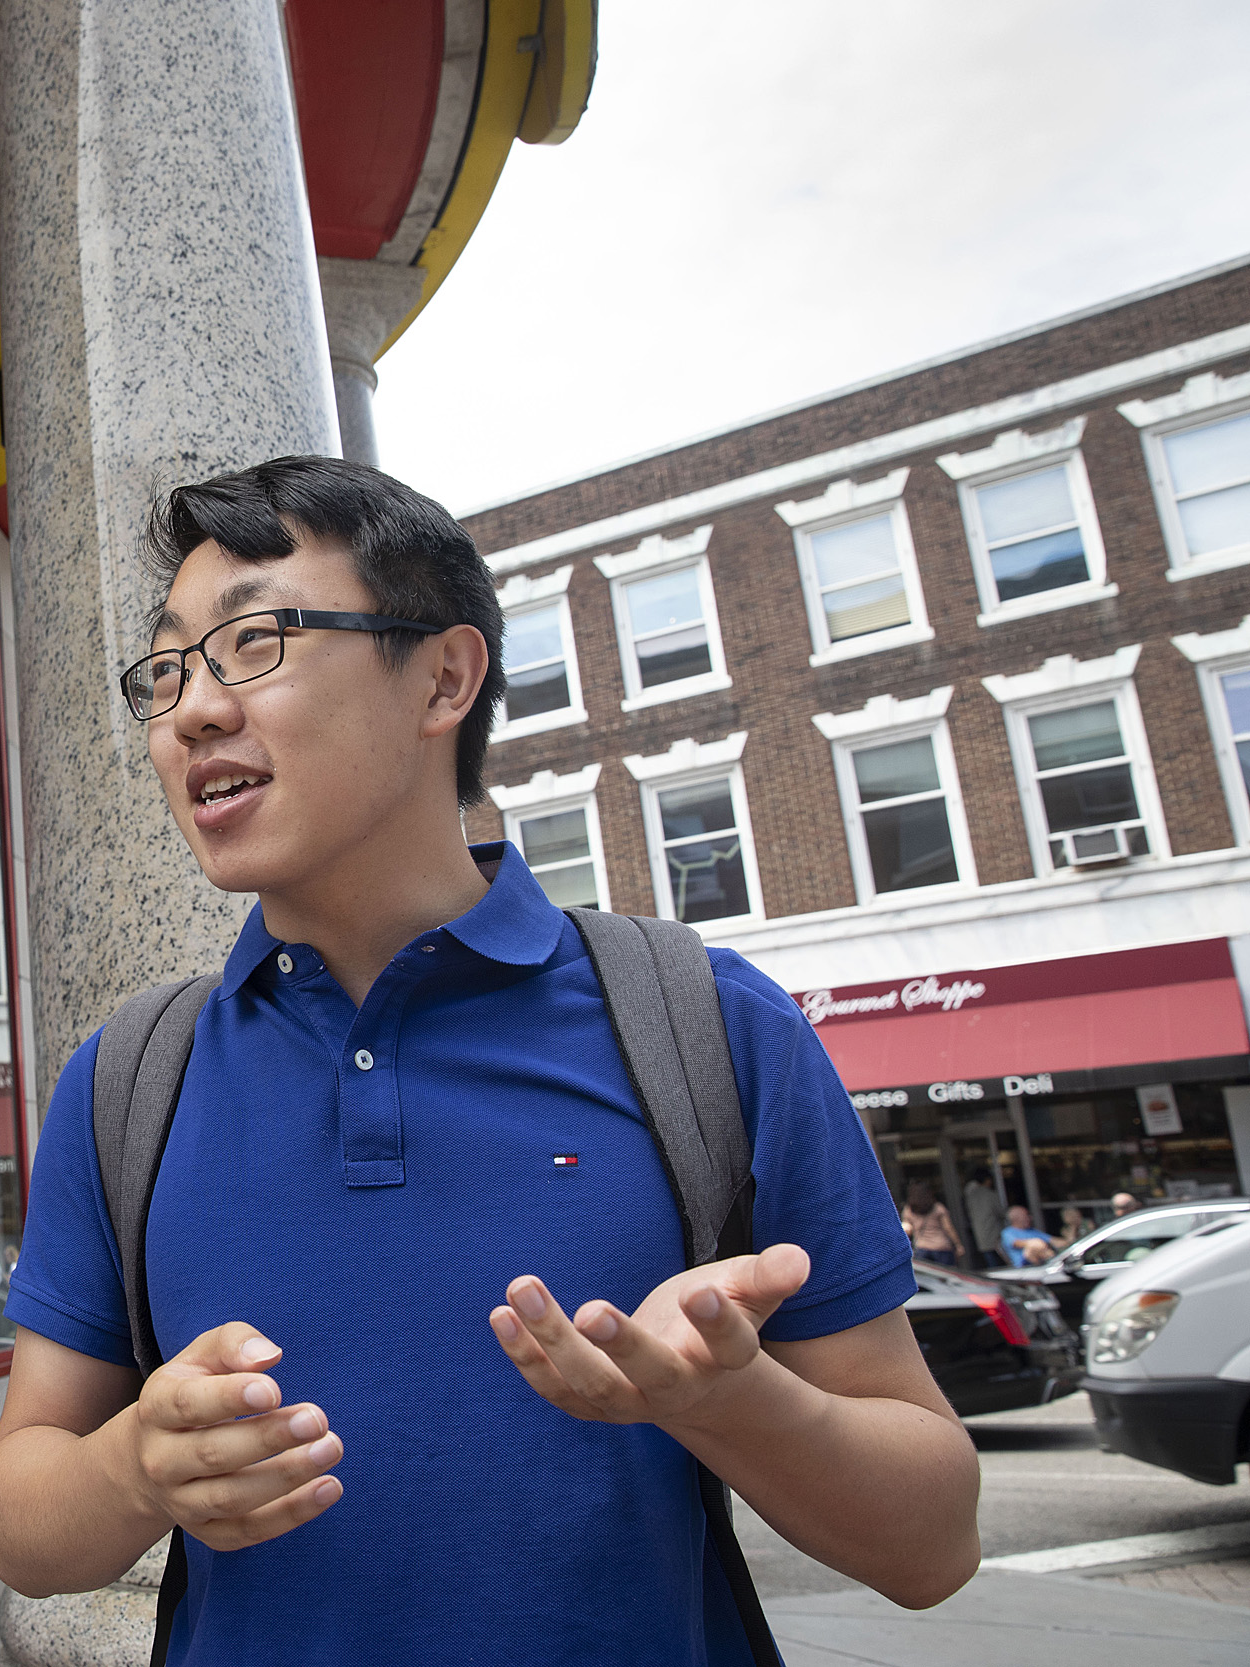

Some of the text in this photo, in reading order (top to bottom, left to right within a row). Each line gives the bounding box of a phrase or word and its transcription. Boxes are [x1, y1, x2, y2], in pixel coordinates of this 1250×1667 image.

[802, 975, 986, 1025] Gourmet Shoppe
[849, 1073, 1054, 1110] eese Gifts Deli
